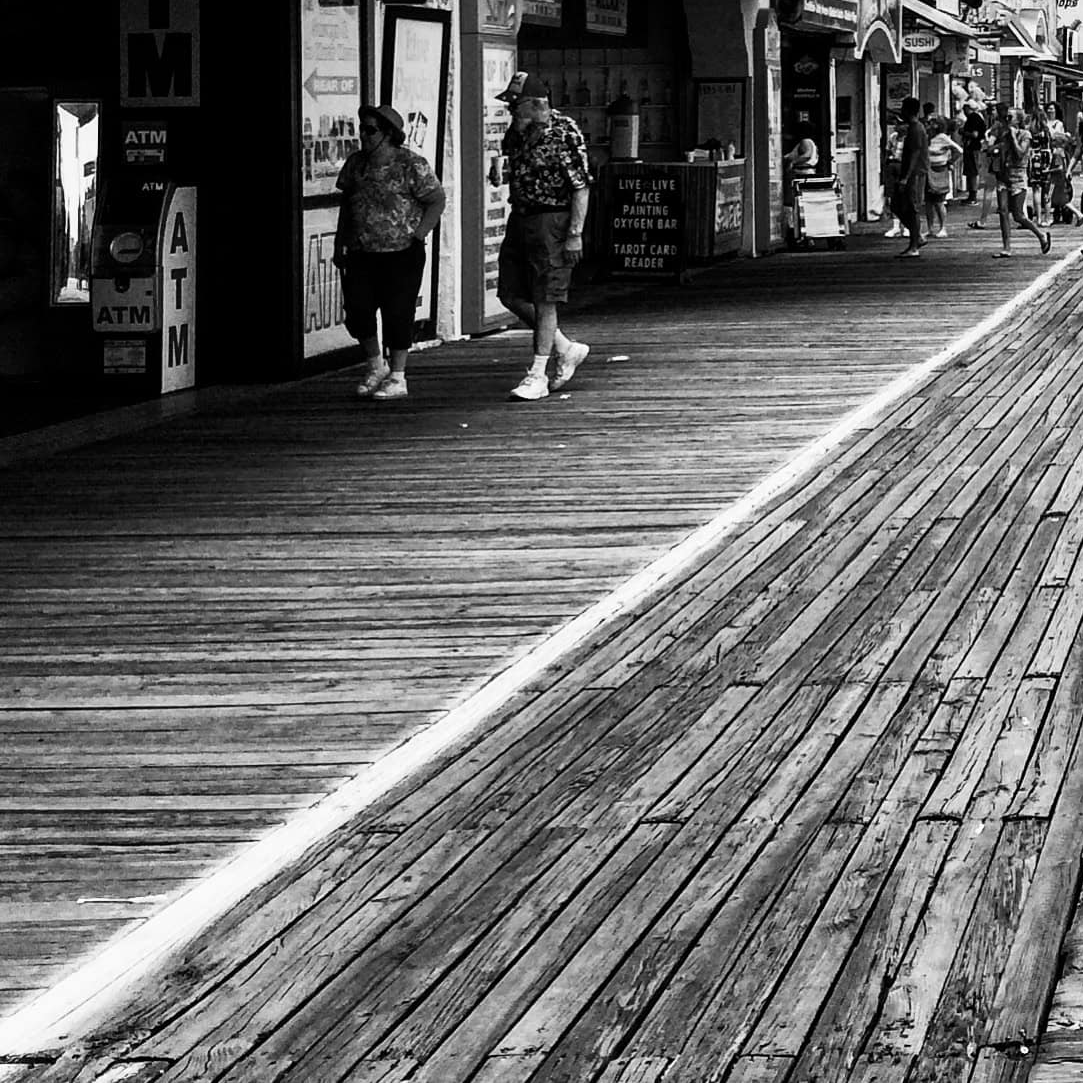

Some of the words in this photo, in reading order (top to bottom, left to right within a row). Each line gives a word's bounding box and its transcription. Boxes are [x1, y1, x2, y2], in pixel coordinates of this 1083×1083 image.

[904, 35, 935, 47] SUSHI
[313, 79, 338, 93] REAR
[340, 79, 354, 93] OF
[125, 130, 167, 145] ATM
[141, 182, 164, 192] ATM
[618, 179, 641, 190] LIVE
[652, 179, 676, 191] LIVE
[634, 192, 661, 203] FACE
[623, 204, 669, 216] PAINTING
[614, 217, 654, 229] OXYGEN
[657, 218, 678, 229] BAR
[613, 244, 646, 255] TAROT
[649, 244, 678, 256] CARD
[624, 257, 664, 269] READER
[169, 212, 189, 368] ATM
[97, 306, 151, 325] ATM
